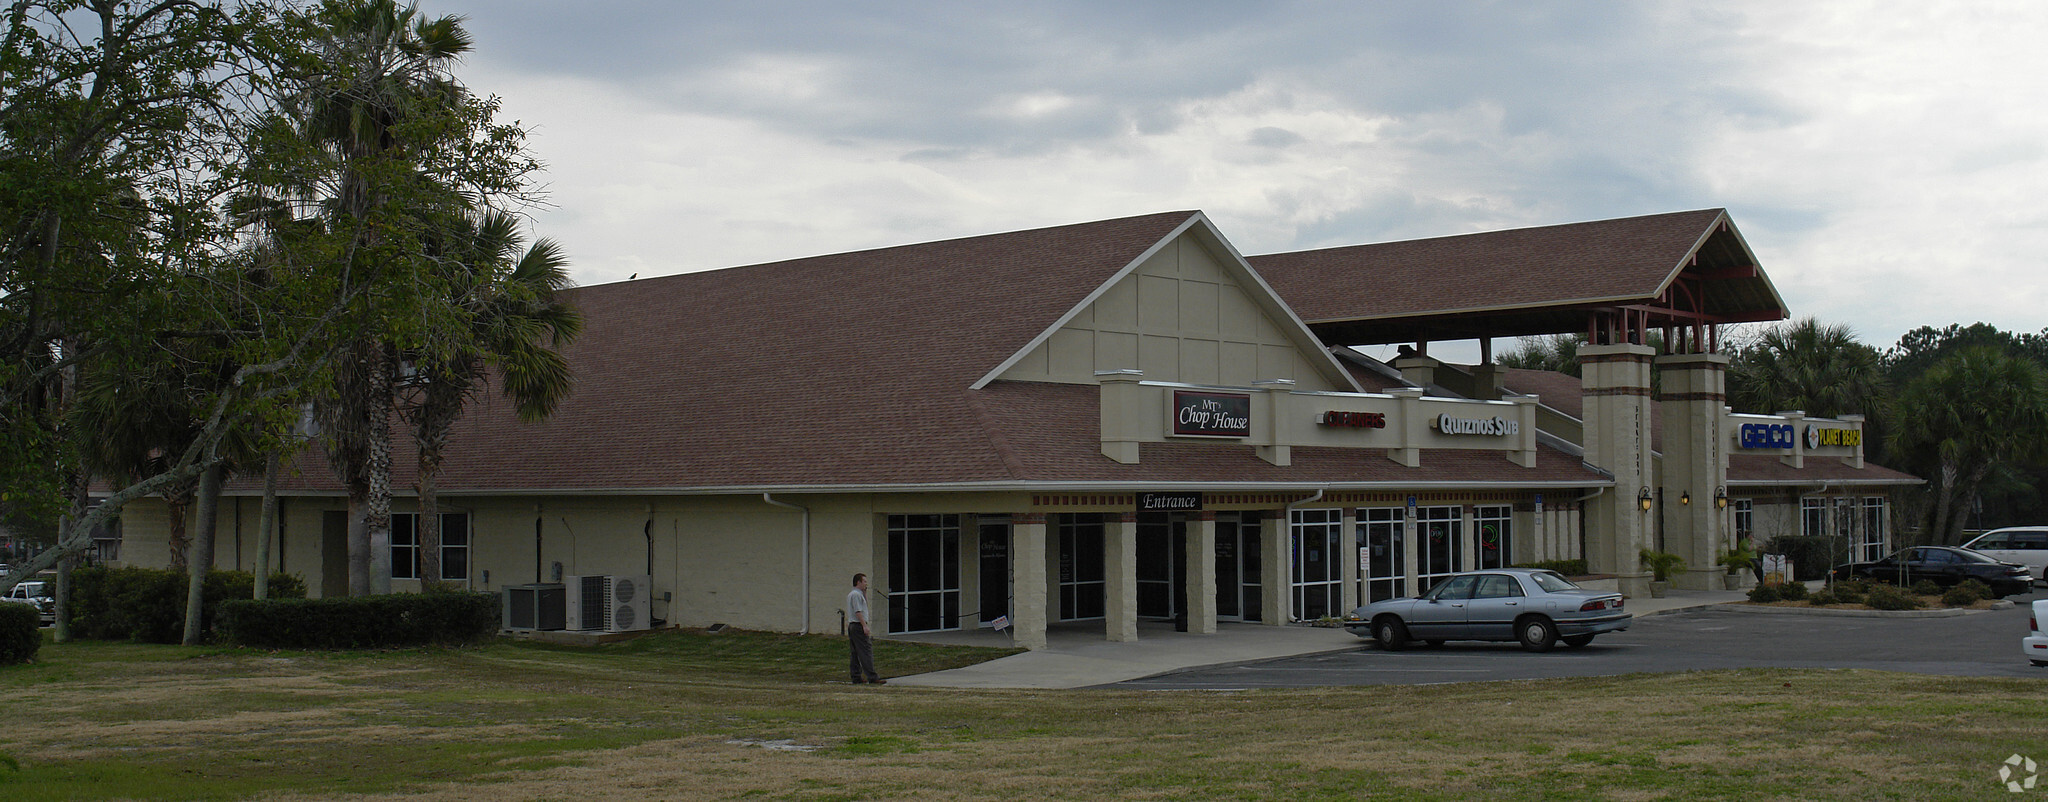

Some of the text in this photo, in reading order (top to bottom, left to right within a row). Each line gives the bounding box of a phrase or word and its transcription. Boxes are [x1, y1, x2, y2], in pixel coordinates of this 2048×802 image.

[1179, 405, 1248, 429] Chop House
[1327, 410, 1386, 429] CLEANERS
[1741, 423, 1794, 449] GEICO
[1818, 428, 1841, 446] PLANET
[1842, 429, 1861, 447] BEACH
[1143, 493, 1196, 509] Entrance
